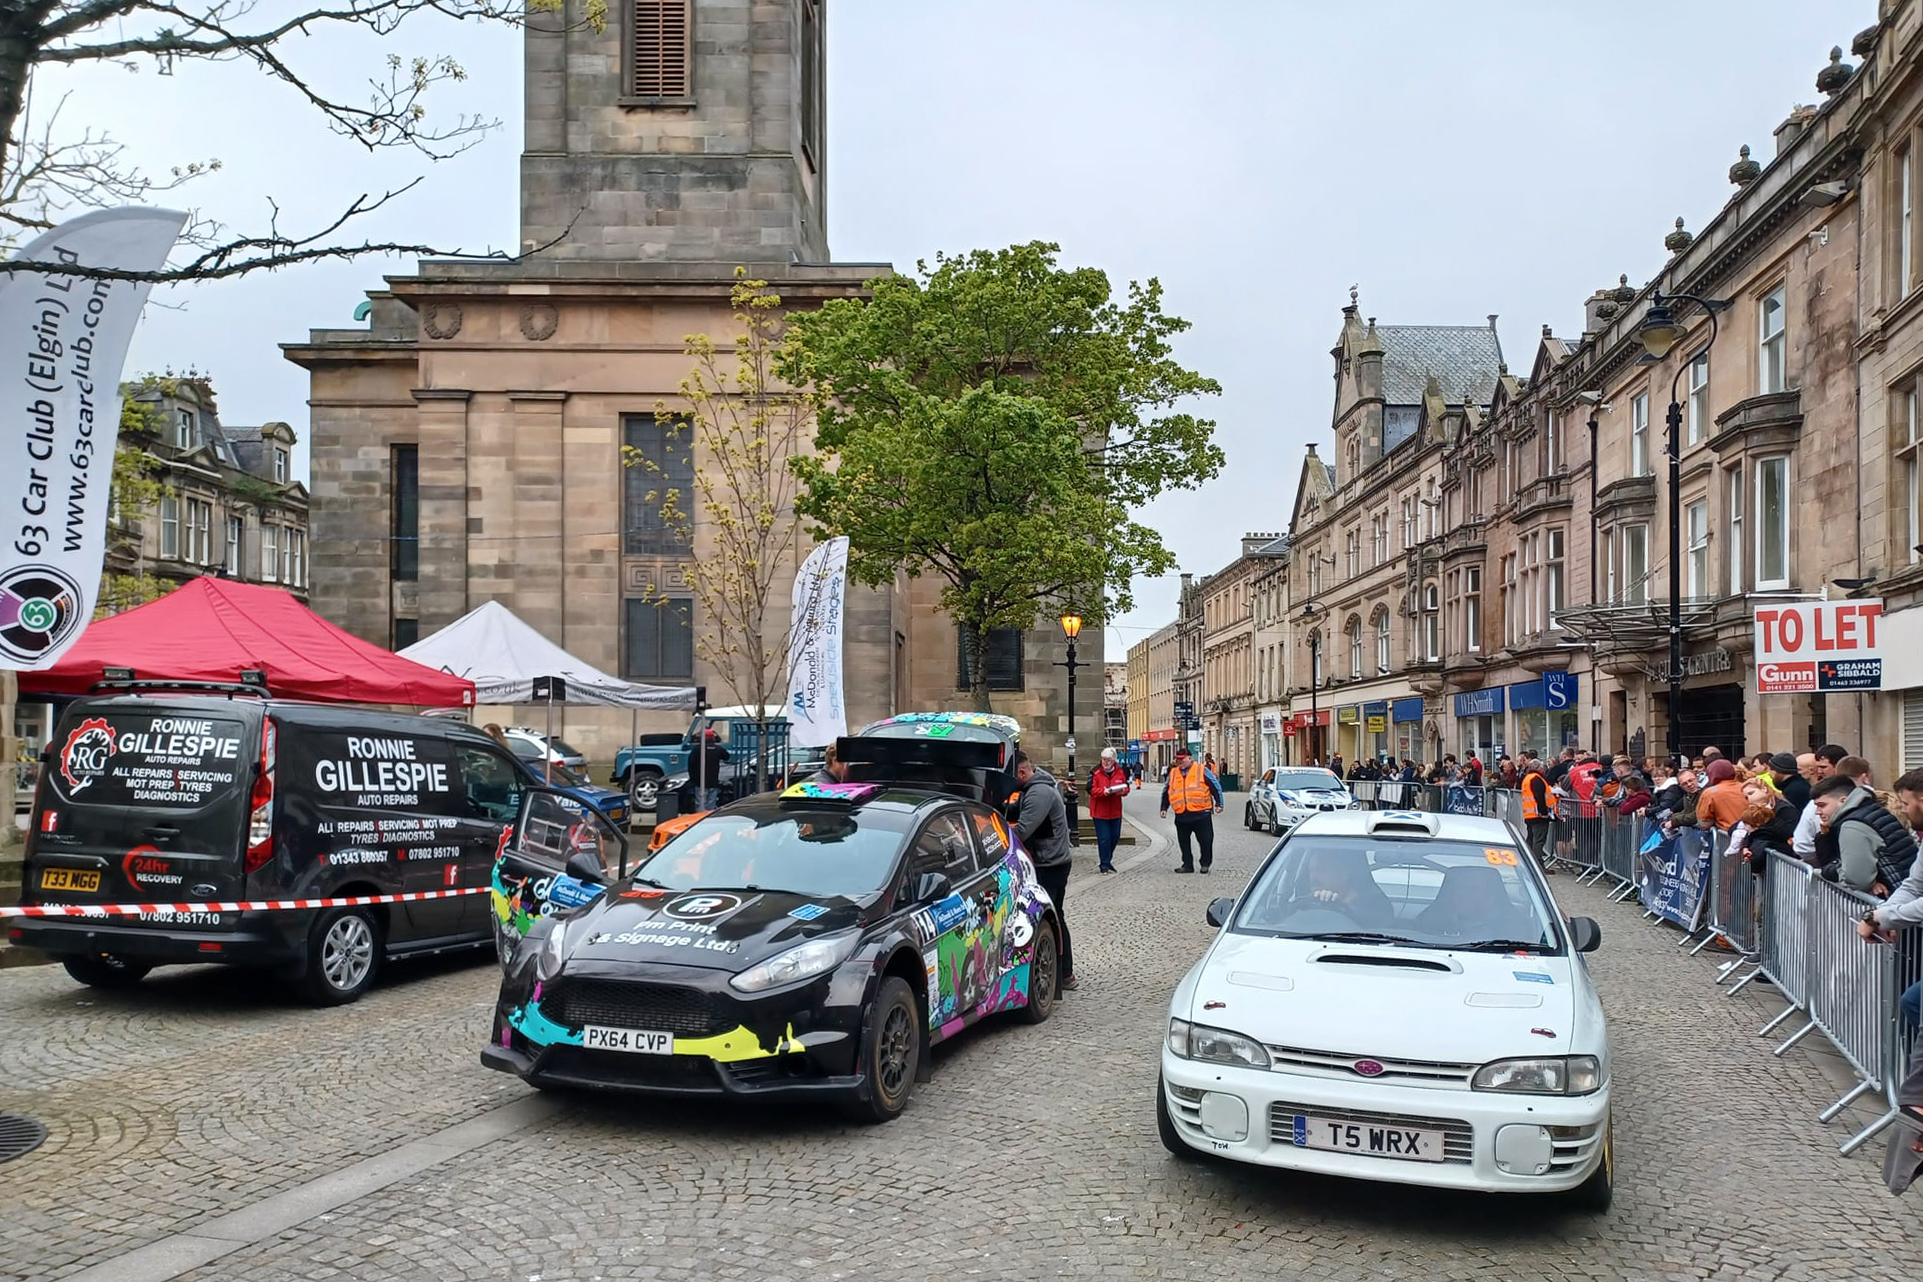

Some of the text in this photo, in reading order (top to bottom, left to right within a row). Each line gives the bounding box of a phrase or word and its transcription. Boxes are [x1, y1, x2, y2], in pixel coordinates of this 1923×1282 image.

[15, 245, 78, 556] 63 Car Club (Elgin) Ld
[1756, 604, 1883, 653] TO LET
[1687, 650, 1731, 675] CENTRE
[1836, 662, 1880, 671] GRAHAM
[1548, 674, 1565, 682] WH
[1760, 664, 1814, 682] Gunn
[1837, 669, 1880, 678] SIBBALD
[1460, 691, 1494, 714] WHSmith
[1548, 682, 1566, 708] S
[151, 719, 213, 735] RONNIE
[118, 732, 240, 759] GILLESPIE
[347, 737, 416, 760] RONNIE
[75, 746, 107, 771] RG
[145, 755, 201, 766] AUTO REPAIRS
[112, 766, 232, 783] ALL REPAIRS SERVICING
[315, 759, 449, 792] GILLESPIE
[126, 778, 212, 792] MOT PREP TYRES
[133, 790, 200, 803] DIAGNOSTICS
[358, 794, 418, 806] AUTO REPAIRS
[338, 821, 375, 833] REPAIRS
[378, 820, 420, 831] SERVICING
[350, 831, 435, 845] TYRES DIAGNOSTICS
[329, 853, 359, 865] 01343
[409, 848, 432, 860] 07802
[433, 846, 460, 859] 951710
[1484, 847, 1518, 867] 83
[134, 858, 171, 873] 24hr
[44, 870, 67, 887] T33
[136, 873, 183, 884] RECOVERY
[176, 912, 220, 925] 951710
[668, 920, 718, 935] Print
[597, 931, 726, 951] & Signage Ltd
[588, 1028, 668, 1051] PX64 CVP
[1327, 1123, 1421, 1155] T5 WRX
